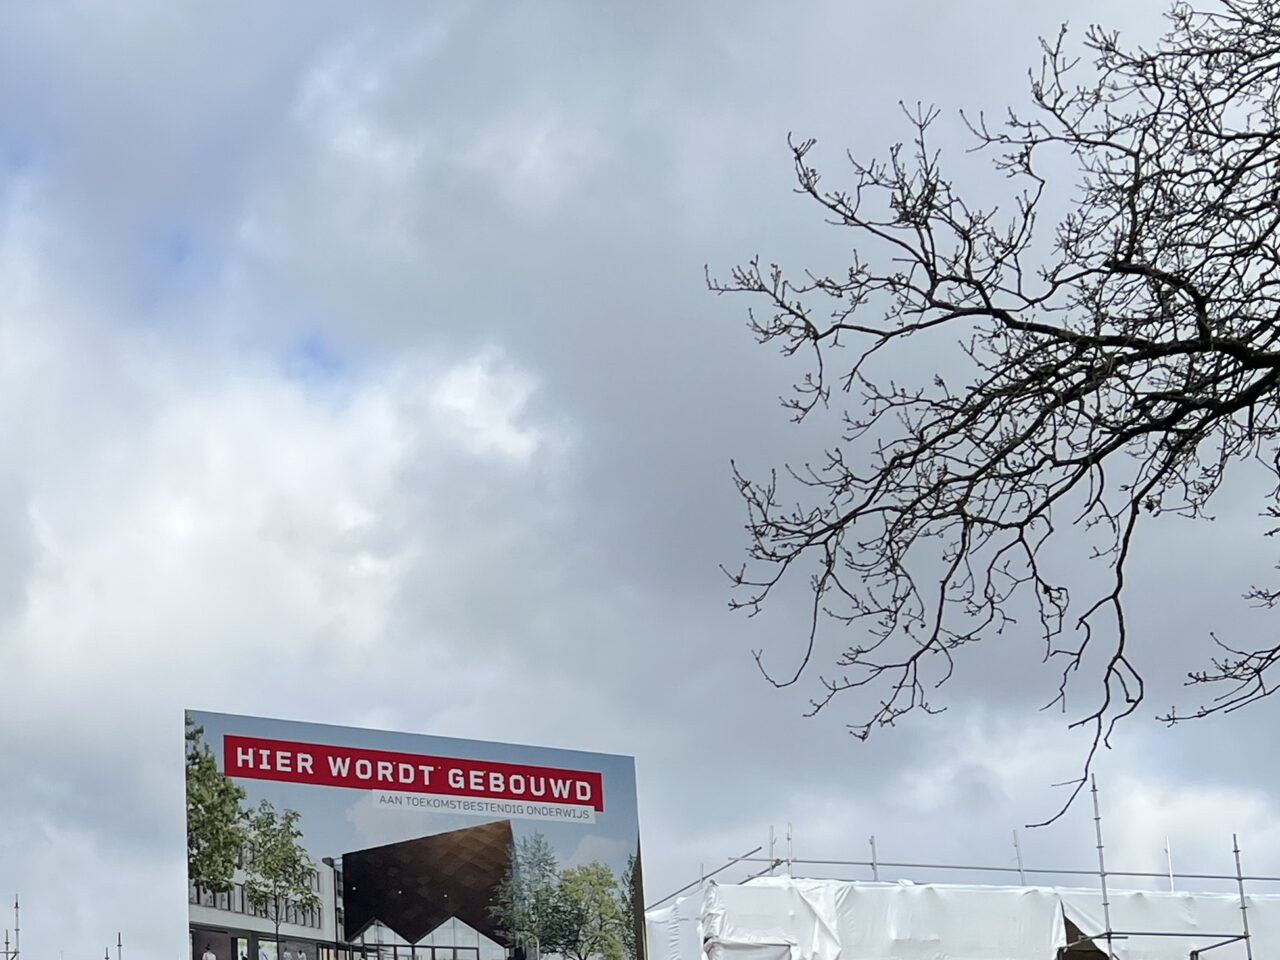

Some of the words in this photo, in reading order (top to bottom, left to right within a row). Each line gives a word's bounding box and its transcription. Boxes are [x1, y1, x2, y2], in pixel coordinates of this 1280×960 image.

[236, 747, 314, 774] HIER
[328, 756, 434, 785] WORDT
[448, 768, 592, 801] GEBOUWD
[379, 795, 403, 807] AAN
[406, 796, 524, 815] TOEKOMSTBESTENDIG
[526, 805, 590, 820] ONDERWIJS
